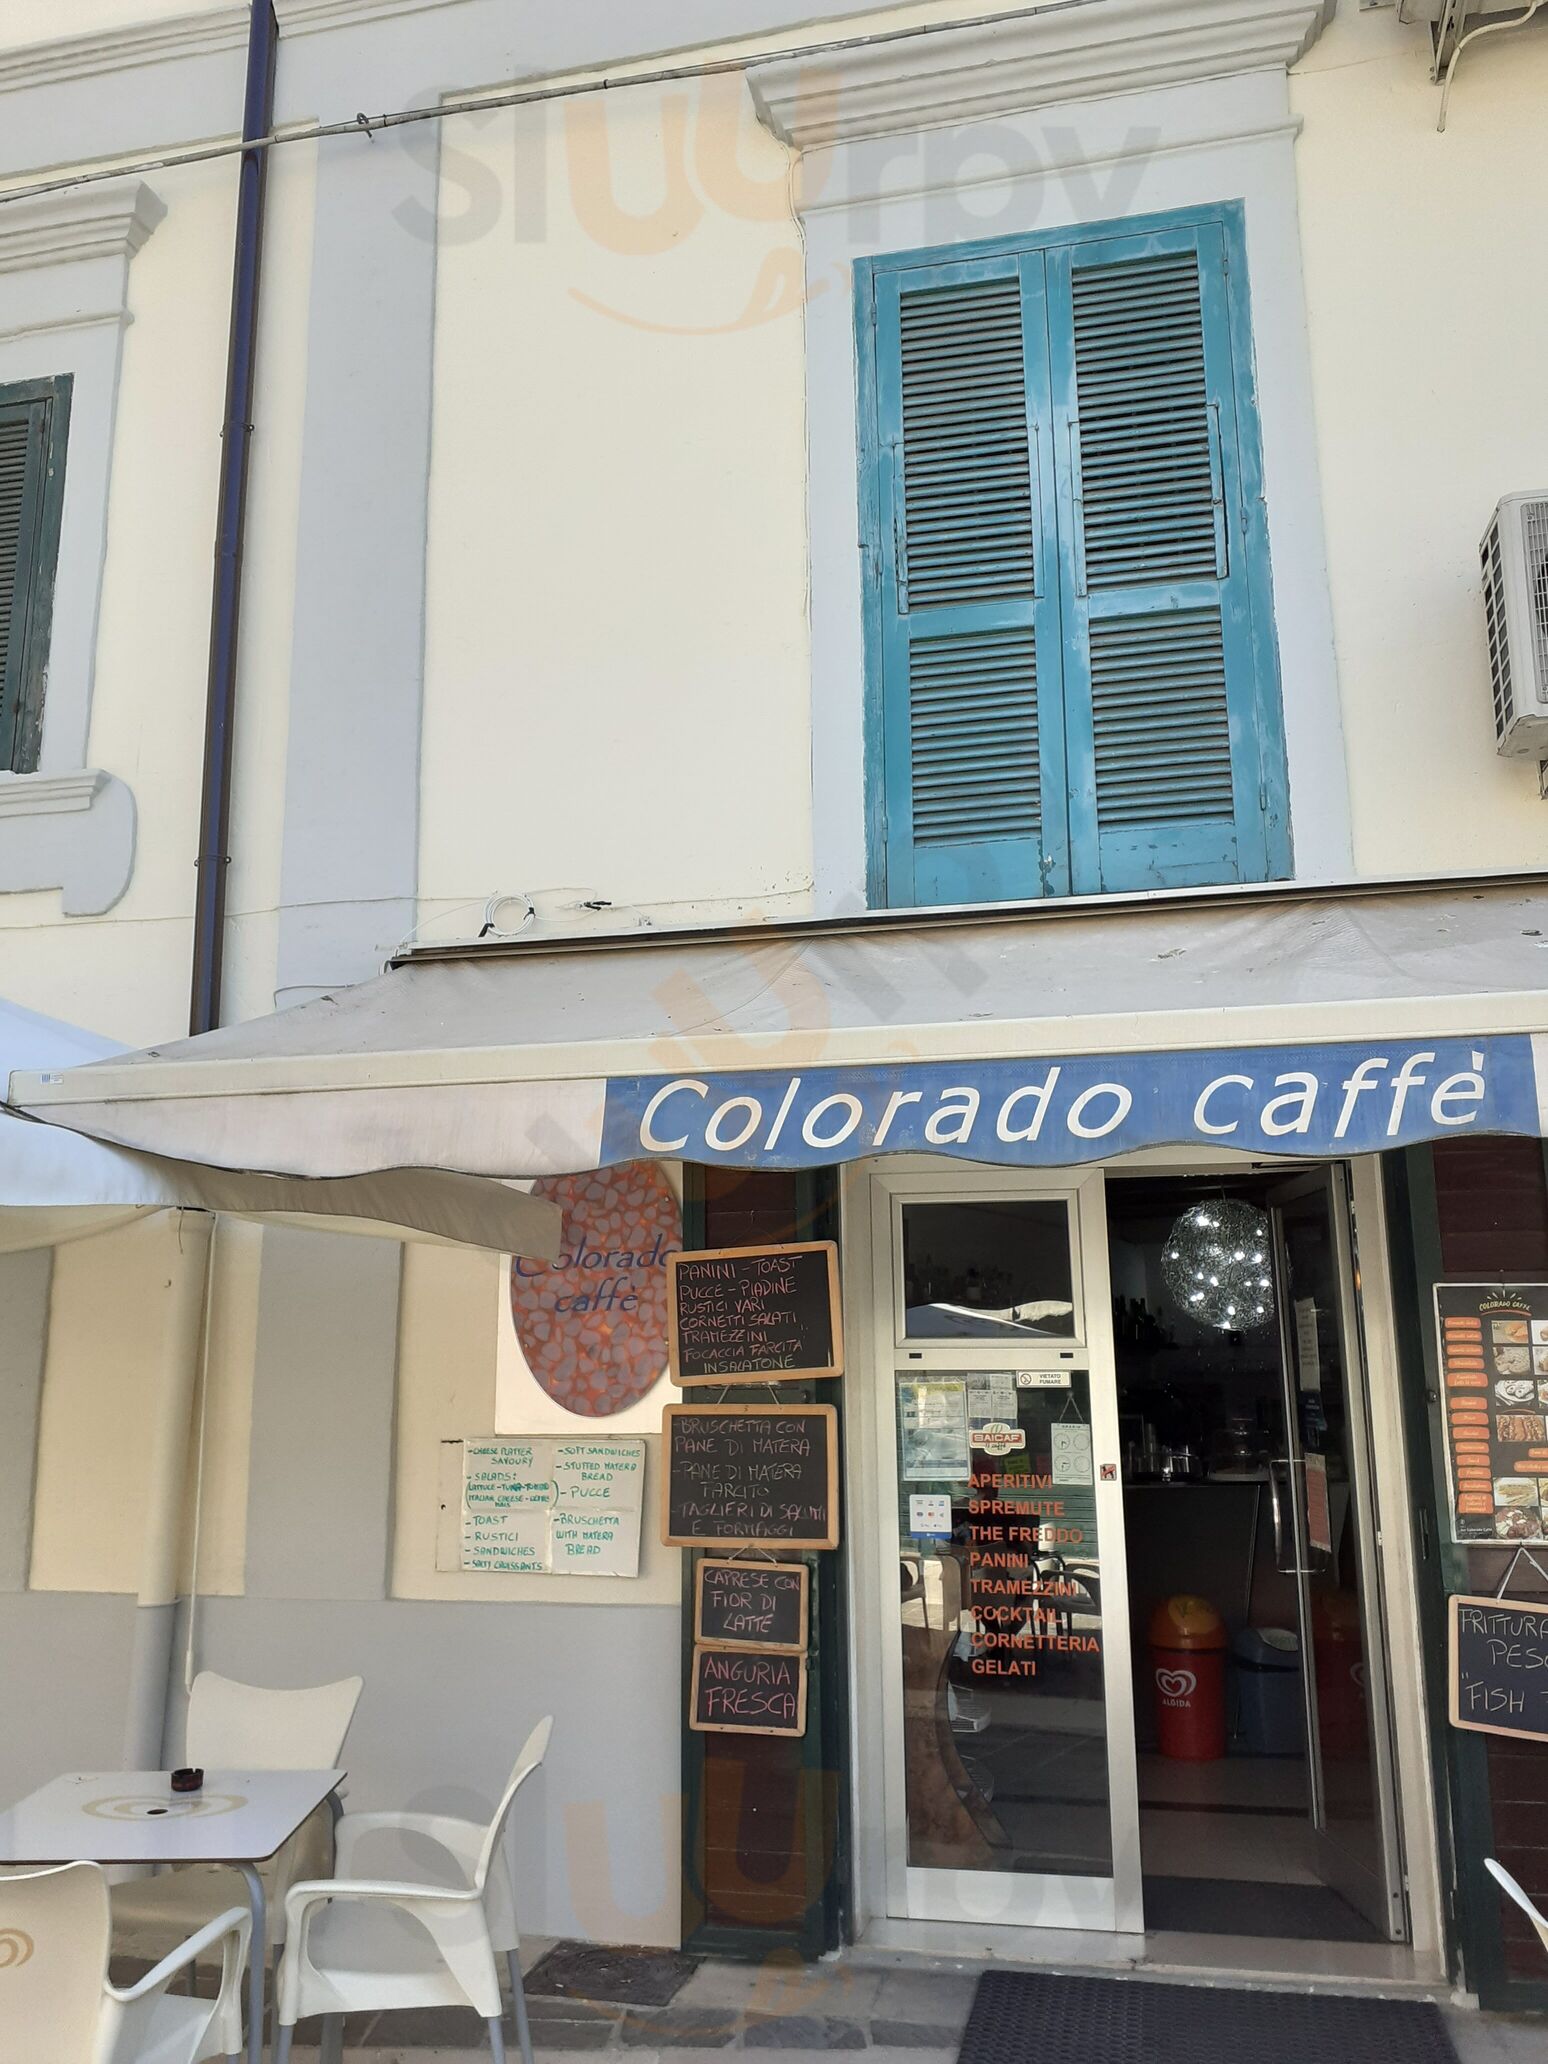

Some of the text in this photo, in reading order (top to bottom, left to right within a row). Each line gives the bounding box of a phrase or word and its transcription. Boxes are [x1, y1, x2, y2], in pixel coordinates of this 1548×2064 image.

[639, 1050, 1486, 1153] Colorado caffè
[679, 1262, 736, 1281] PANINI
[752, 1255, 803, 1276] TOAST
[554, 1276, 638, 1313] caffè
[679, 1284, 725, 1301] PUCCE
[738, 1276, 797, 1297] PIADINE
[679, 1296, 765, 1316] RUSTICI VARI
[679, 1311, 797, 1331] CORNETTI SALATI
[682, 1329, 768, 1345] TRAMEZZINI
[683, 1339, 803, 1362] FOCACCIA FARCITA
[704, 1354, 796, 1374] INSALATONE
[775, 1419, 806, 1434] CON
[674, 1436, 811, 1457] PANE DI MATERA
[973, 1434, 1020, 1442] SAICAF
[587, 1447, 641, 1457] SANDWICHES
[491, 1457, 533, 1468] SAVOURY
[725, 1464, 742, 1480] DI
[748, 1462, 802, 1481] MATERA
[581, 1473, 613, 1481] BREAD
[968, 1474, 1053, 1489] APERITIVI
[570, 1486, 611, 1498] PUCCE
[759, 1503, 773, 1517] DI
[968, 1500, 1065, 1517] SPREMUTE
[472, 1515, 508, 1526] TOAST
[691, 1519, 794, 1537] E FORMAGGI
[475, 1532, 519, 1542] RUSTICI
[556, 1531, 578, 1540] WITH
[969, 1526, 1084, 1544] THE FREDDO
[473, 1547, 536, 1556] SANDWICHES
[566, 1544, 601, 1555] BREAD
[970, 1552, 1029, 1568] PANINI
[704, 1569, 800, 1591] CAPRESE CON
[971, 1579, 1078, 1597] TRAMEZZINI
[710, 1590, 776, 1612] FIOR DI
[723, 1612, 775, 1633] LATTE
[971, 1605, 1063, 1624] COCKTAIL
[972, 1632, 1100, 1652] CORNETTERIA
[704, 1656, 791, 1685] ANGURIA
[972, 1659, 1037, 1676] GELATI
[705, 1686, 796, 1719] FRESCA
